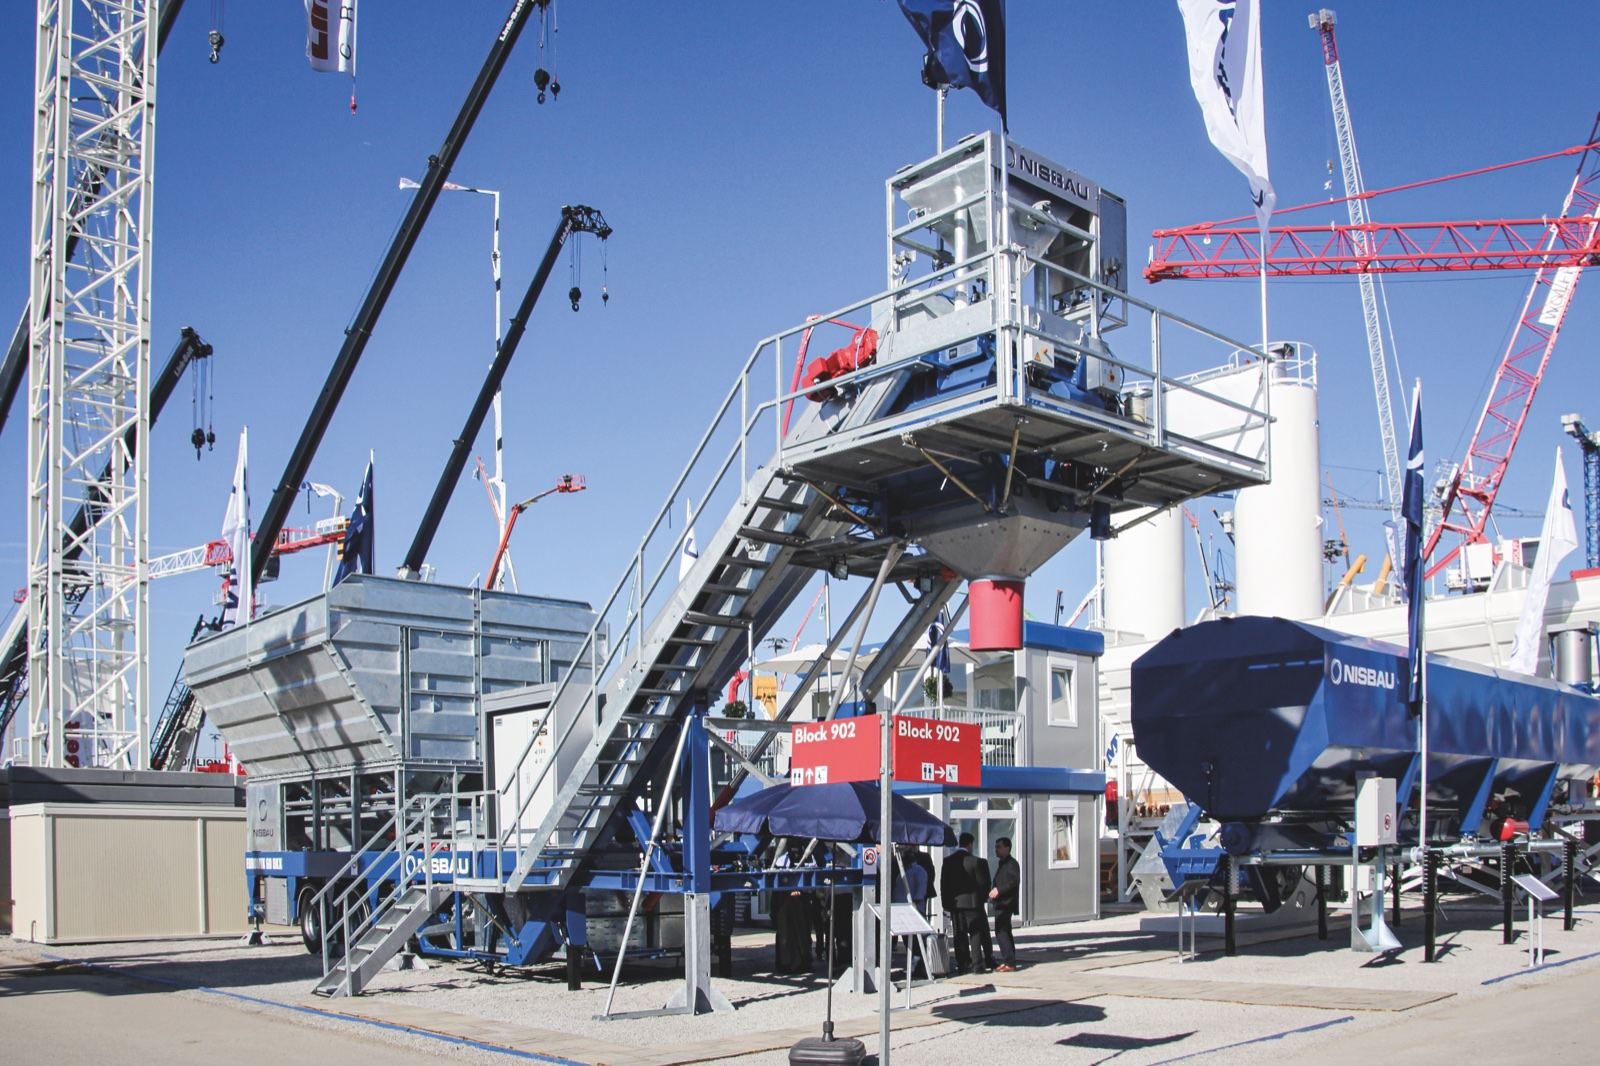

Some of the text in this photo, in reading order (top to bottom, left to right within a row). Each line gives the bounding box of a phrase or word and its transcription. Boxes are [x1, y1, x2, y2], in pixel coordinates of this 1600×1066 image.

[1020, 154, 1089, 200] NISBAU
[1343, 664, 1395, 690] NISBAU
[795, 721, 856, 744] Block 902
[898, 720, 960, 743] Block 902
[417, 857, 469, 875] NSBAU
